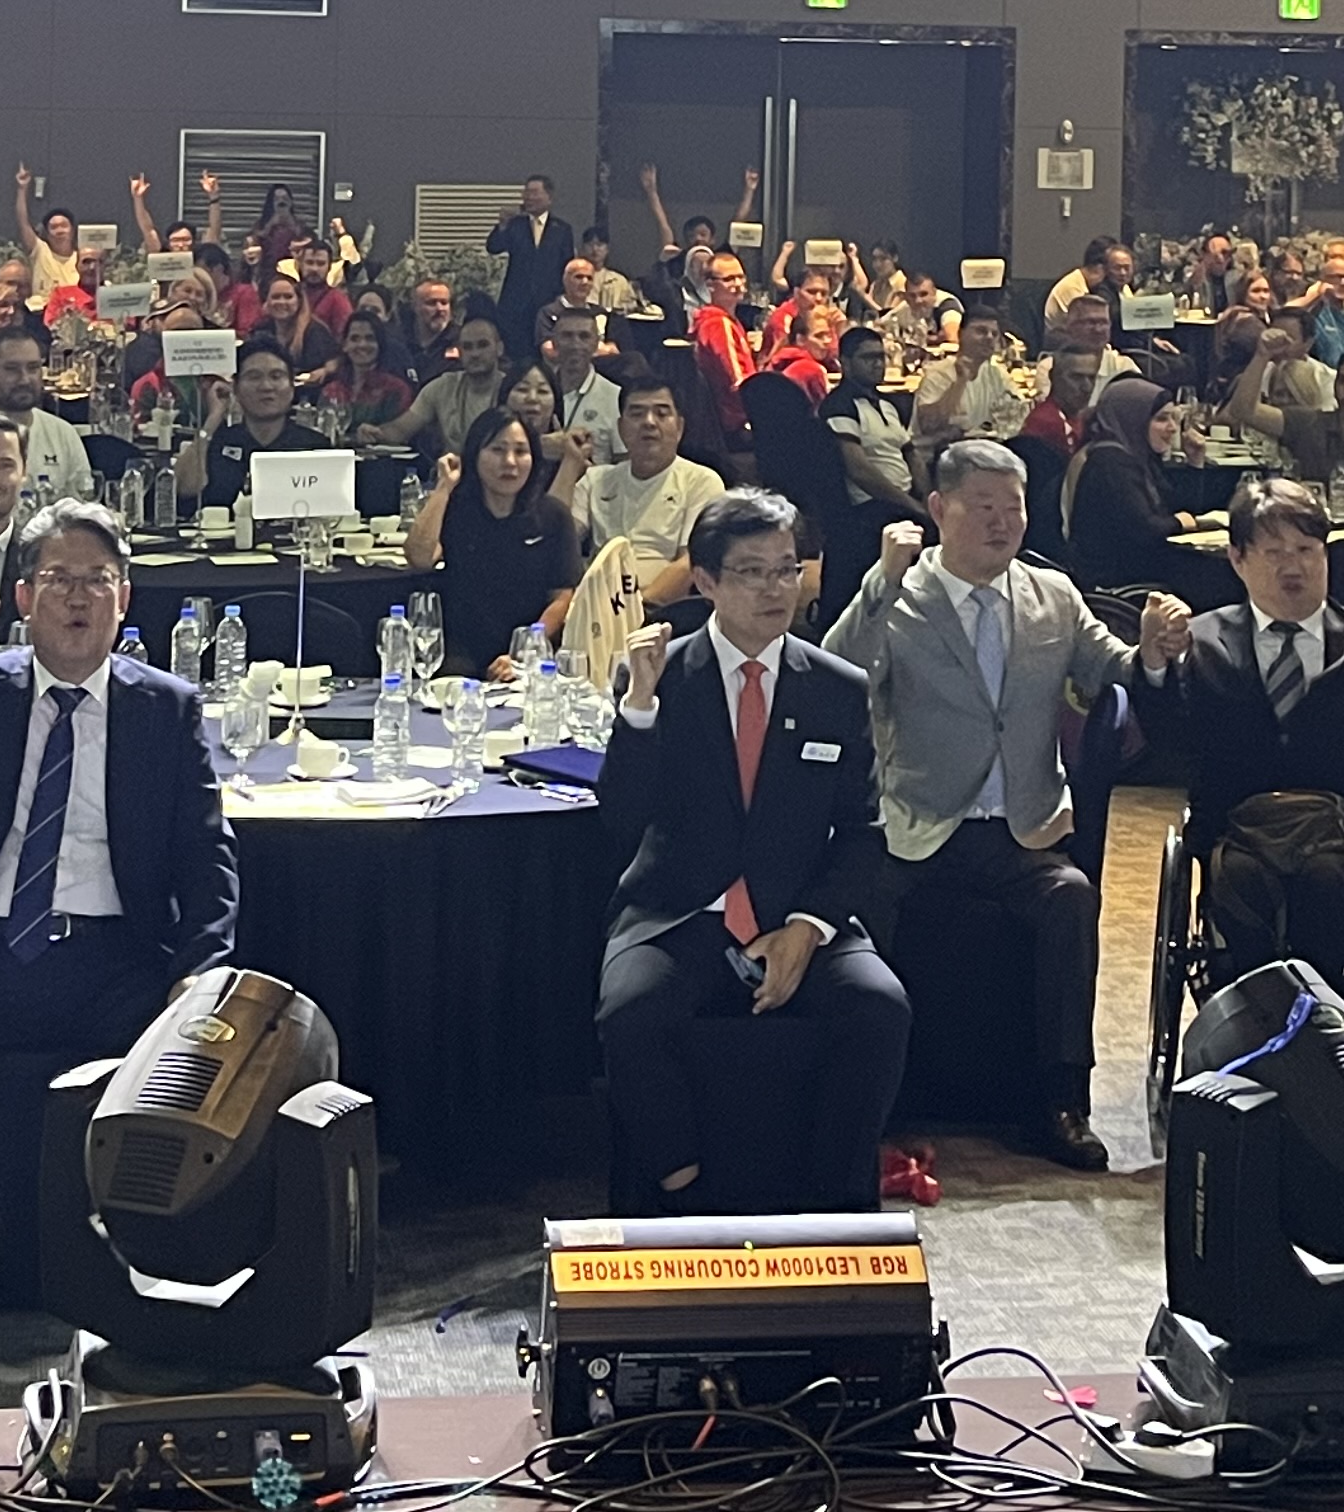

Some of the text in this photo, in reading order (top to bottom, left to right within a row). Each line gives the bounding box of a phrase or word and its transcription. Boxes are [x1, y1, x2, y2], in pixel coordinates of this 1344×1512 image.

[291, 475, 318, 488] VIP
[570, 1260, 644, 1281] STROBE
[650, 1259, 760, 1280] COLOURING
[869, 1256, 909, 1276] RGB
